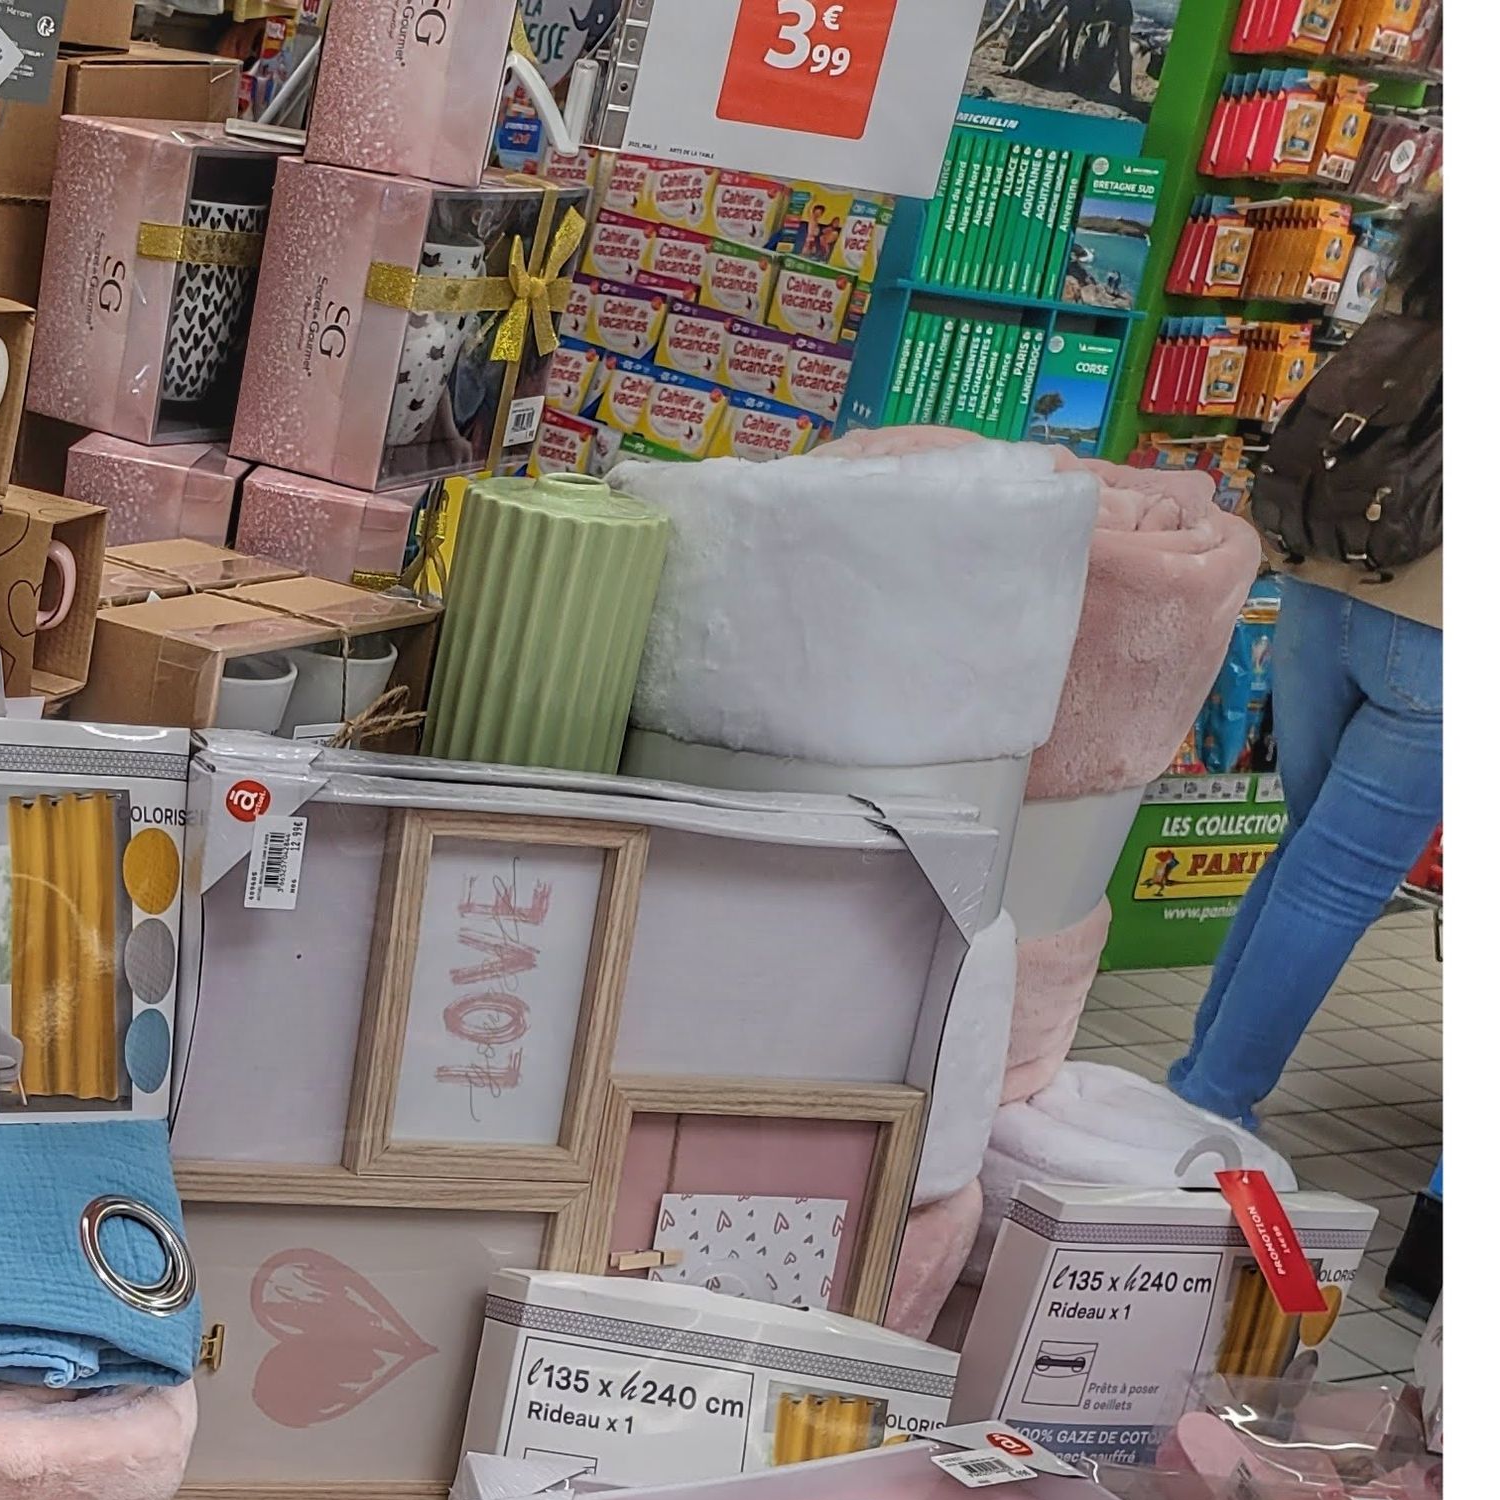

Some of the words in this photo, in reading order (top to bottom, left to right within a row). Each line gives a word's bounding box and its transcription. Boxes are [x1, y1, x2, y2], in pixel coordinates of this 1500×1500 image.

[957, 111, 1019, 131] MICHELIN
[660, 173, 692, 187] Cahier
[1002, 156, 1019, 197] ALSACE
[1014, 158, 1029, 198] ALSACE
[656, 187, 702, 202] vacances
[722, 190, 753, 204] Cahier
[945, 199, 959, 232] Alpes
[955, 161, 967, 187] Nord
[1022, 160, 1041, 218] AQUITAINE
[1035, 162, 1055, 221] AQUITAINE
[1093, 179, 1137, 194] BRETAGNE
[1138, 183, 1155, 196] SUD
[958, 202, 971, 234] Alpes
[968, 163, 980, 189] Nord
[1059, 178, 1078, 232] Auvergne
[716, 206, 765, 222] vacances
[973, 197, 986, 226] Alpes
[984, 198, 996, 228] Alpes
[599, 228, 630, 244] Cahier
[594, 245, 640, 260] vacances
[660, 243, 691, 258] Cahier
[655, 260, 701, 276] vacances
[716, 258, 747, 276] Cahier
[99, 255, 126, 313] SG
[711, 277, 757, 293] vacances
[787, 276, 822, 296] Cahier
[603, 299, 637, 316] Cahier
[781, 293, 833, 313] vacances
[319, 301, 351, 360] SG
[598, 317, 647, 333] vacances
[674, 319, 709, 338] Cahier
[669, 336, 720, 355] vacances
[734, 341, 771, 360] Cahier
[728, 359, 784, 378] vacances
[797, 356, 836, 376] Cahier
[892, 338, 912, 392] Bourgogne
[905, 340, 924, 394] Bourgogne
[971, 338, 991, 394] CHARENTES
[1013, 342, 1029, 376] PARIS
[1075, 361, 1109, 375] CORSE
[956, 394, 966, 411] LES
[961, 337, 980, 393] CHARENTES
[1020, 343, 1041, 405] LANGUEDOC
[790, 374, 846, 395] vacances
[658, 388, 694, 406] Cahier
[967, 396, 977, 413] LES
[651, 404, 704, 424] vacances
[742, 414, 780, 433] Cahier
[543, 430, 568, 445] Cahier
[734, 432, 790, 451] vacances
[538, 445, 577, 463] vacances
[1161, 816, 1191, 836] LES
[1186, 849, 1272, 877] PANI
[435, 880, 552, 1090] LOVE
[1247, 1205, 1286, 1276] PROMOTION
[1107, 1279, 1118, 1292] x
[1183, 1276, 1212, 1293] cm
[1047, 1301, 1107, 1320] Rideau
[1108, 1308, 1119, 1320] x
[1123, 1304, 1131, 1320] 1
[1087, 1381, 1116, 1395] Prêts
[1119, 1382, 1126, 1395] à
[1130, 1384, 1159, 1397] poser
[598, 1381, 612, 1398] x
[706, 1395, 744, 1418] cm
[1083, 1400, 1089, 1411] 8
[1091, 1399, 1132, 1412] oeillets
[528, 1401, 599, 1431] Rideau
[605, 1418, 618, 1433] x
[624, 1416, 634, 1434] 1
[1057, 1430, 1094, 1443] GAZE
[1098, 1431, 1118, 1444] DE
